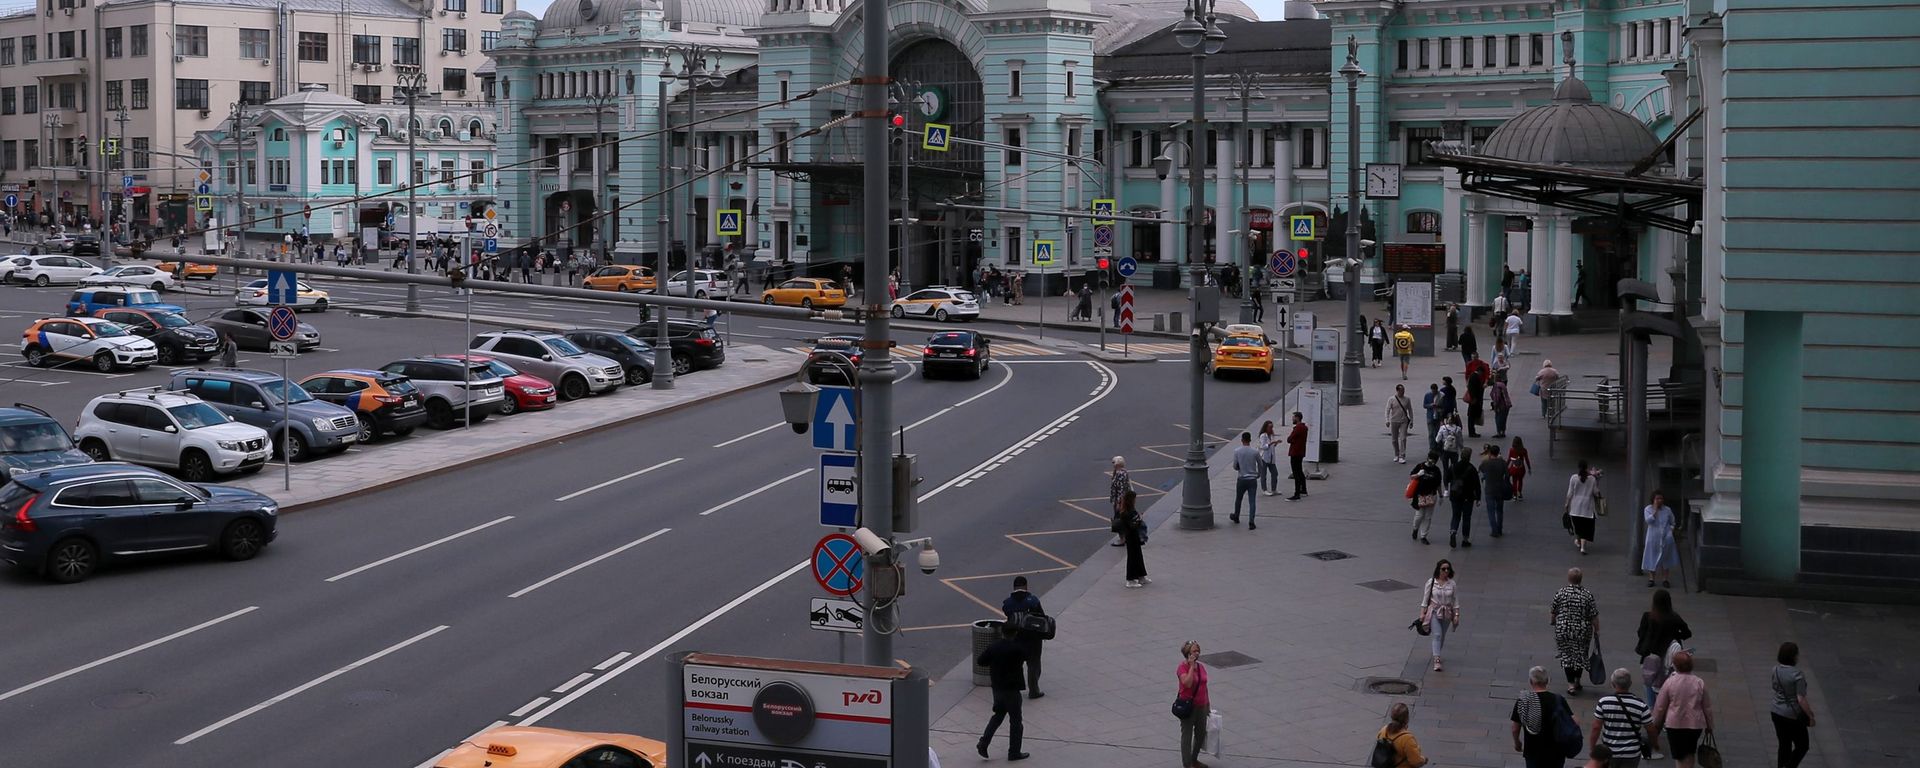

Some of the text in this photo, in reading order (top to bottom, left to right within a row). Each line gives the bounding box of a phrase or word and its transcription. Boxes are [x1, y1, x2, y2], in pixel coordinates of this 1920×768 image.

[487, 239, 495, 251] P
[691, 673, 761, 689] Белорусский
[691, 690, 729, 701] вокзал
[691, 713, 734, 725] Belorussky
[691, 724, 750, 737] railway station
[716, 753, 776, 768] К поездам
